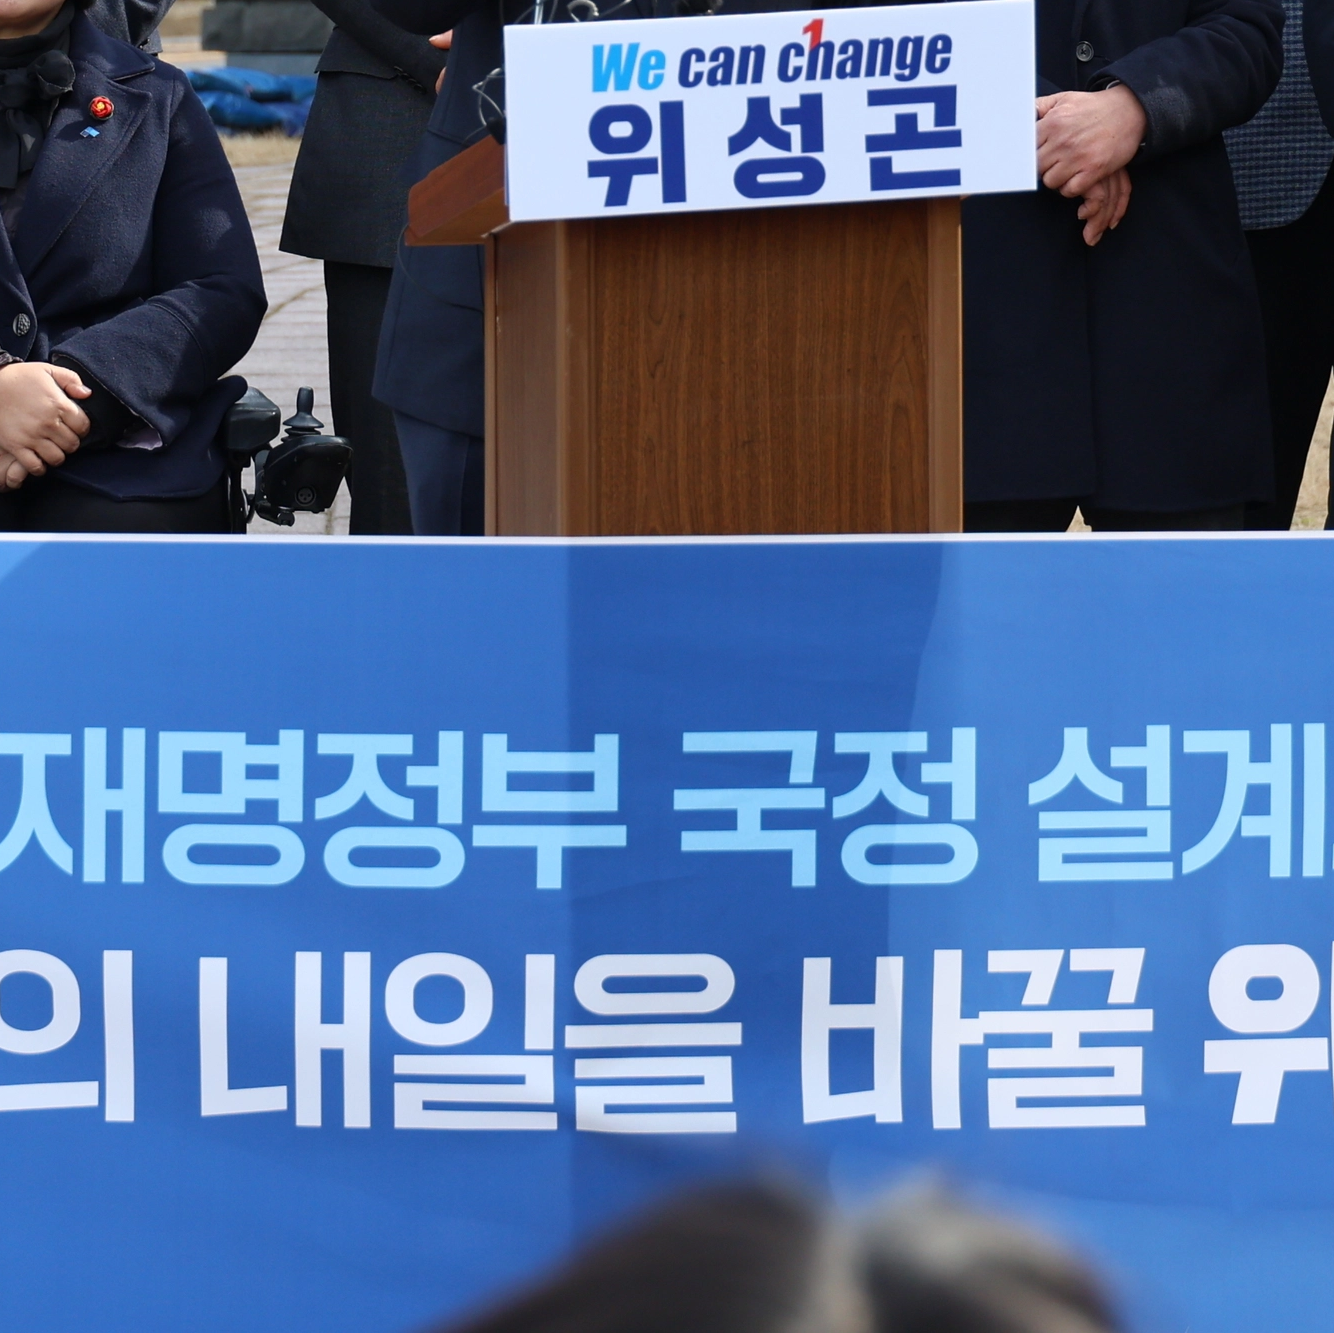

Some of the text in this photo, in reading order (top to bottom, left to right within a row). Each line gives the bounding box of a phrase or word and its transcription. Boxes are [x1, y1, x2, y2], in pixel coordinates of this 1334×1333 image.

[592, 32, 953, 93] We can change
[587, 84, 963, 207] 위성곤
[673, 726, 979, 887] 국정
[199, 950, 743, 1134] 내일을
[801, 947, 1155, 1130] 바꿀
